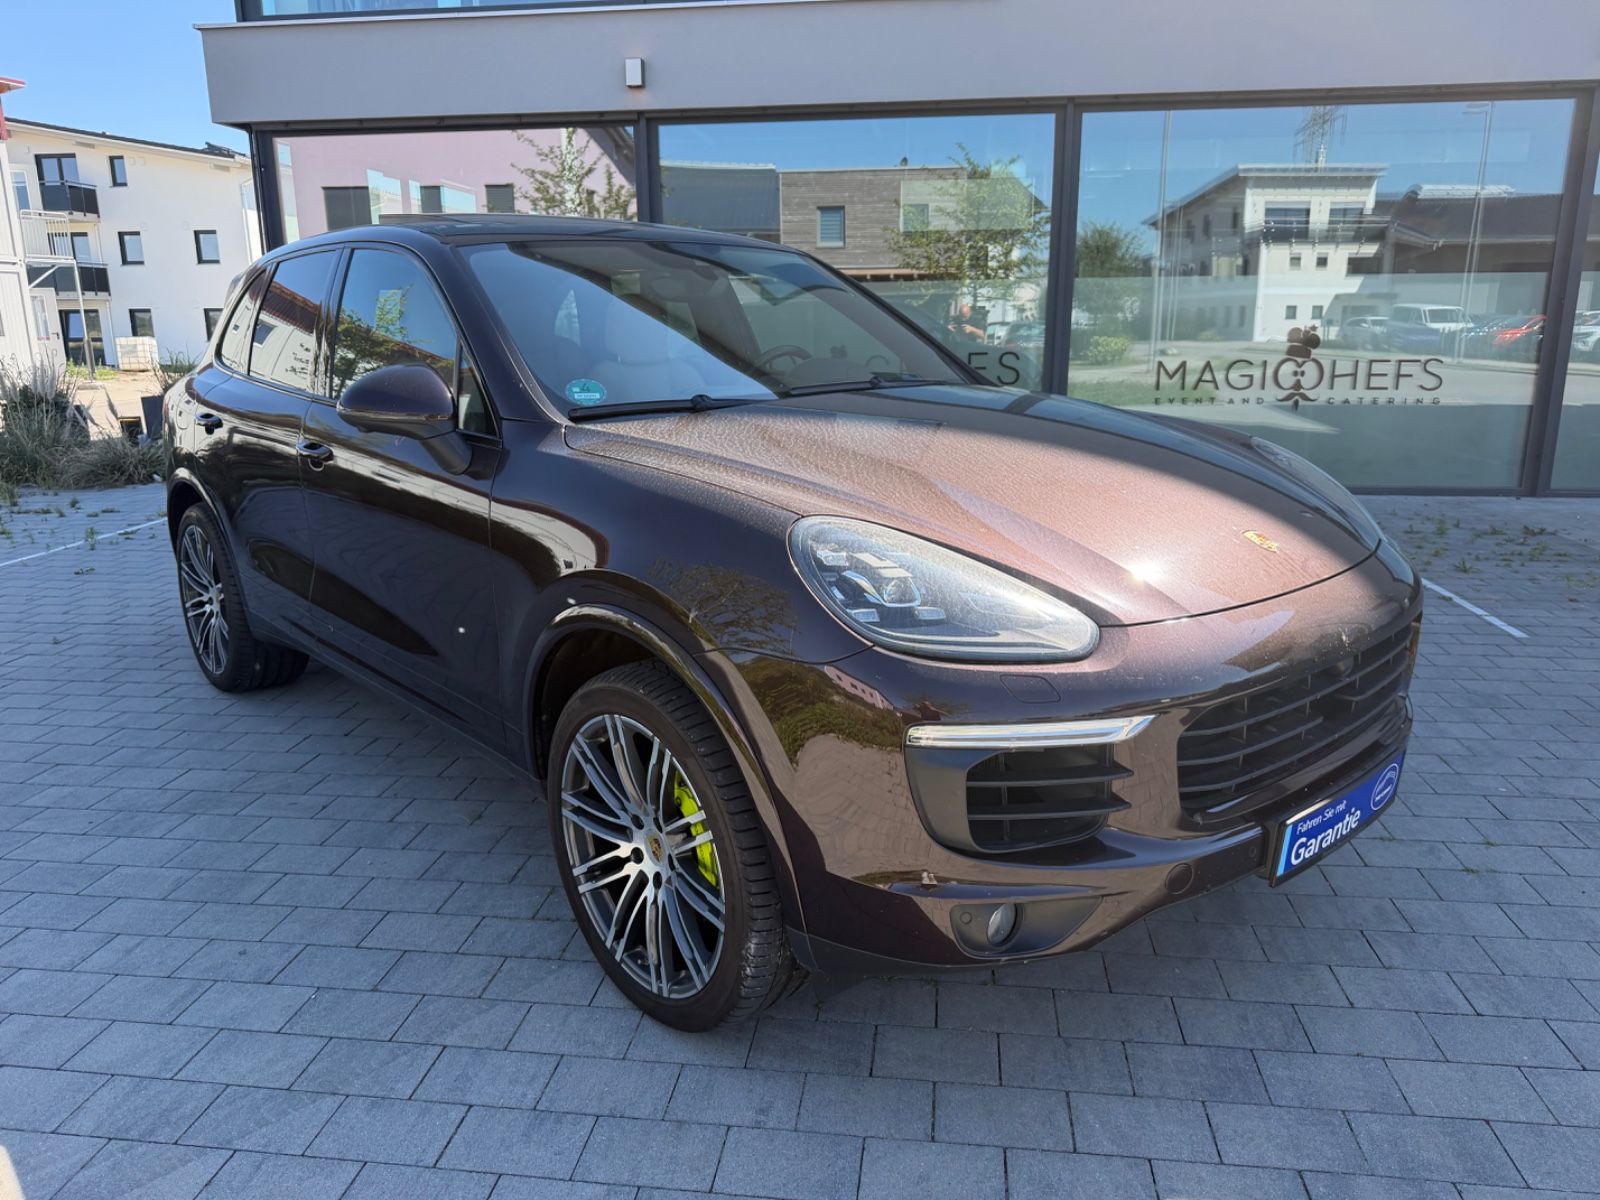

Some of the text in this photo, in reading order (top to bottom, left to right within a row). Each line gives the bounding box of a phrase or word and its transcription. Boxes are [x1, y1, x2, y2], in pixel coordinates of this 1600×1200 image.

[1154, 397, 1441, 405] EVENT AND CATERING
[1296, 800, 1347, 835] Fahren Sie mit
[1290, 808, 1361, 865] Garantie
